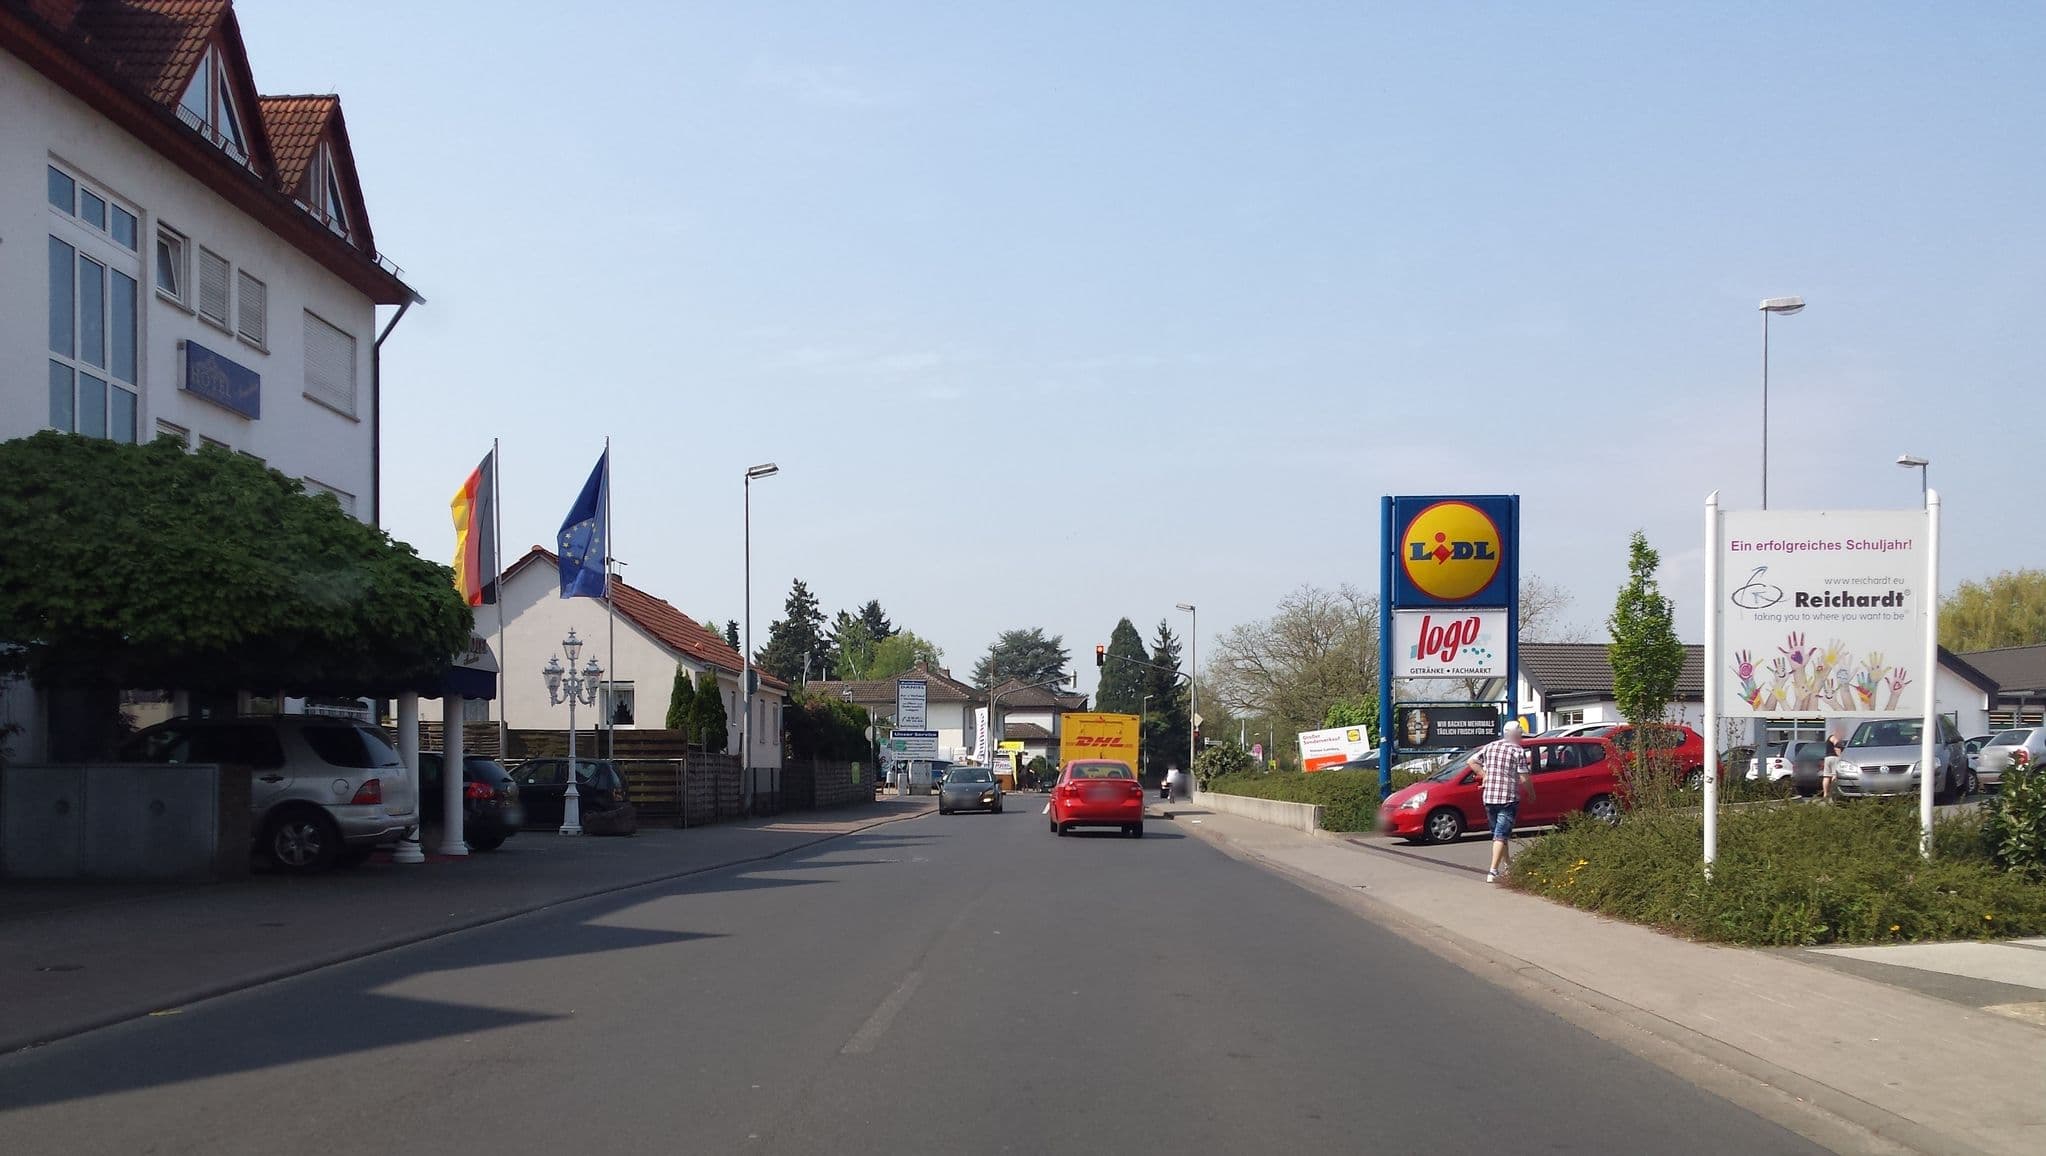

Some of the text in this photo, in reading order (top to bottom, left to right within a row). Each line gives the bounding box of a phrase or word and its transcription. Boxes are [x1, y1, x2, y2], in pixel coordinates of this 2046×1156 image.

[191, 366, 232, 399] HOTEL
[1731, 539, 1912, 553] Ein erfolgreiches Schuljahr!
[1824, 576, 1905, 585] www.reichardt.eu
[1795, 591, 1904, 608] Reichardt
[1753, 611, 1905, 623] taking you to where you want to be
[1417, 615, 1480, 663] logo
[1410, 667, 1492, 675] GETRÄNKE FACHMARKT
[1436, 720, 1495, 728] WIR BACKEN MEHRMALS
[1436, 727, 1457, 736] TÄGLICH
[1074, 736, 1124, 748] DHL
